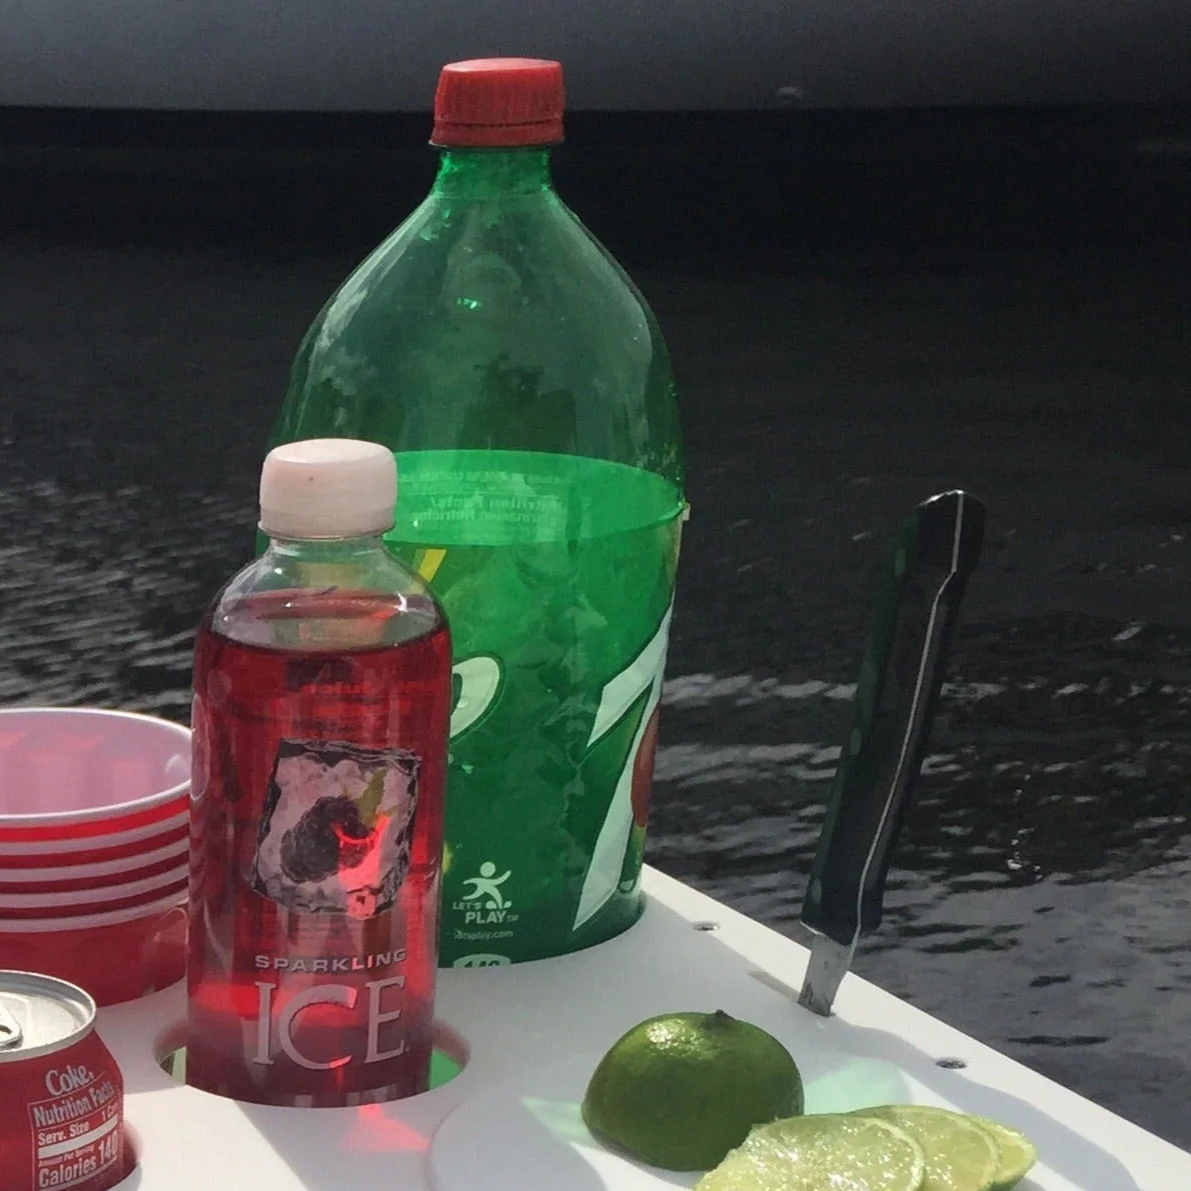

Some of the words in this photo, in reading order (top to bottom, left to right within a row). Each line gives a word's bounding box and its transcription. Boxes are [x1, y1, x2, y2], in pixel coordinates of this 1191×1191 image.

[452, 902, 482, 910] LET'S
[465, 910, 508, 924] PLAY
[255, 948, 408, 973] SPARKLING
[252, 974, 406, 1071] ICE
[45, 1064, 88, 1097] Coke
[33, 1095, 93, 1128] Nutrition
[89, 1080, 115, 1108] Facts
[38, 1131, 67, 1146] Serv.
[69, 1121, 89, 1138] Size
[38, 1156, 97, 1188] Calories
[98, 1130, 118, 1165] 140
